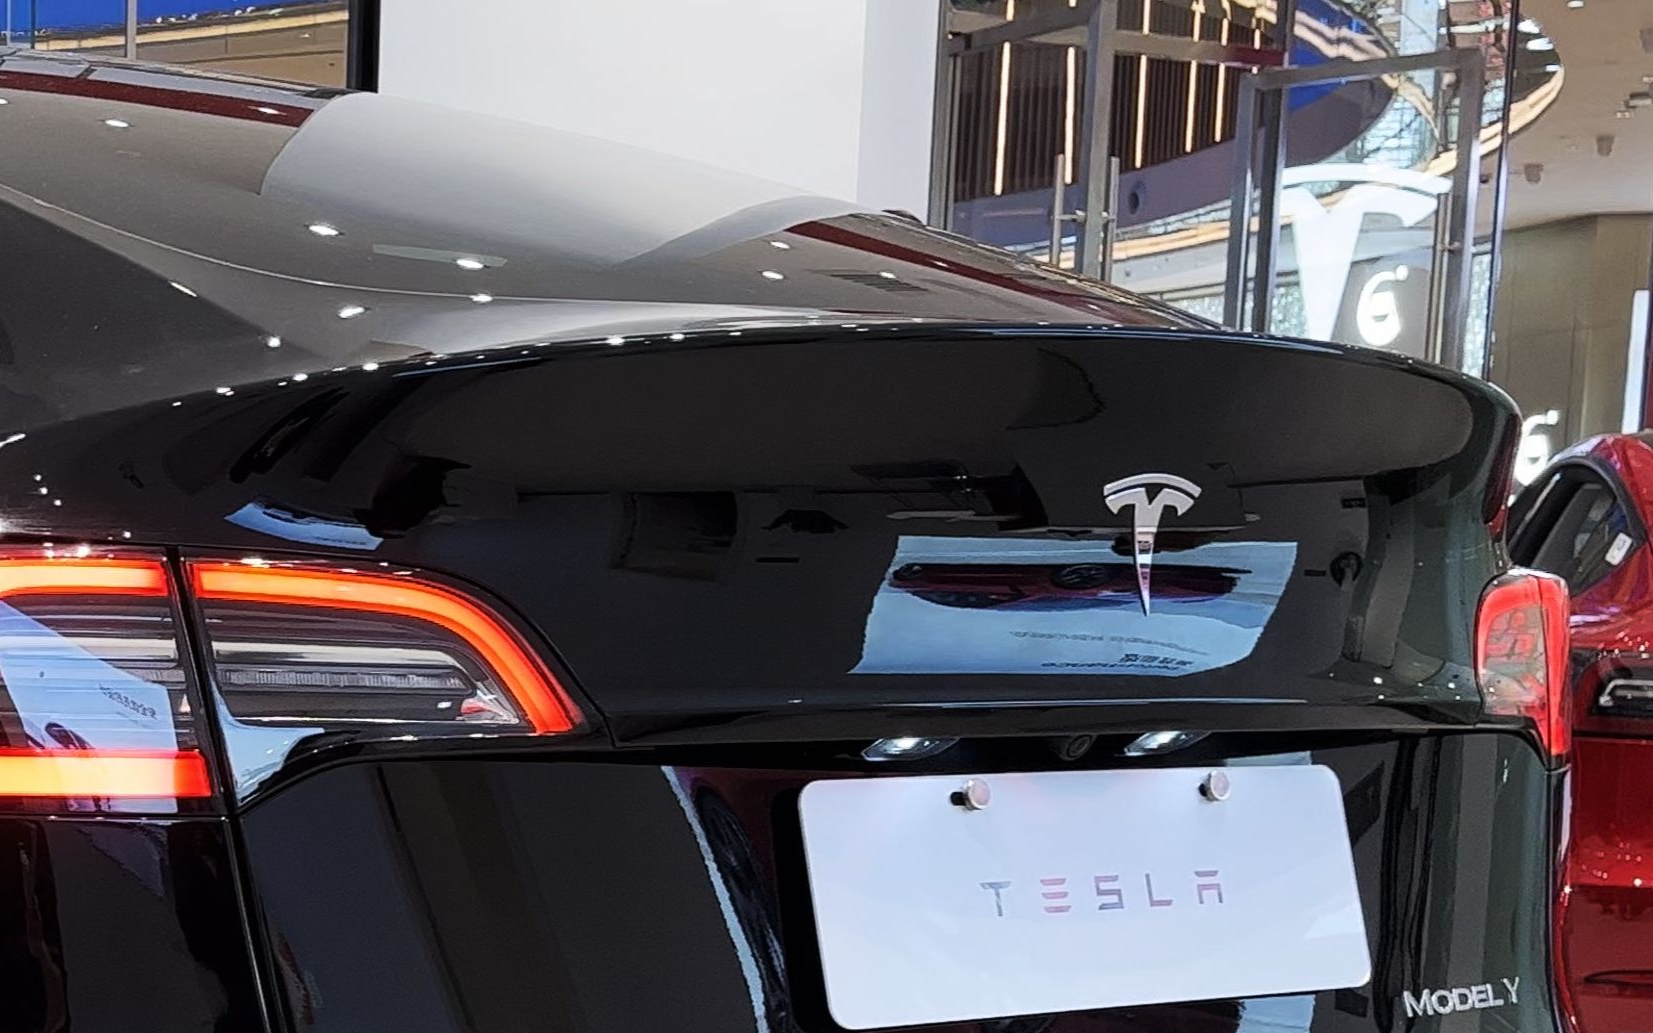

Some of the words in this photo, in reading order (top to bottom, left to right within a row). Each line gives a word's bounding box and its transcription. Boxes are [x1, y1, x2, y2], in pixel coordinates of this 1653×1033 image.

[980, 869, 1224, 917] TESLA
[1403, 983, 1504, 1018] MODEL
[1500, 976, 1519, 1004] Y
